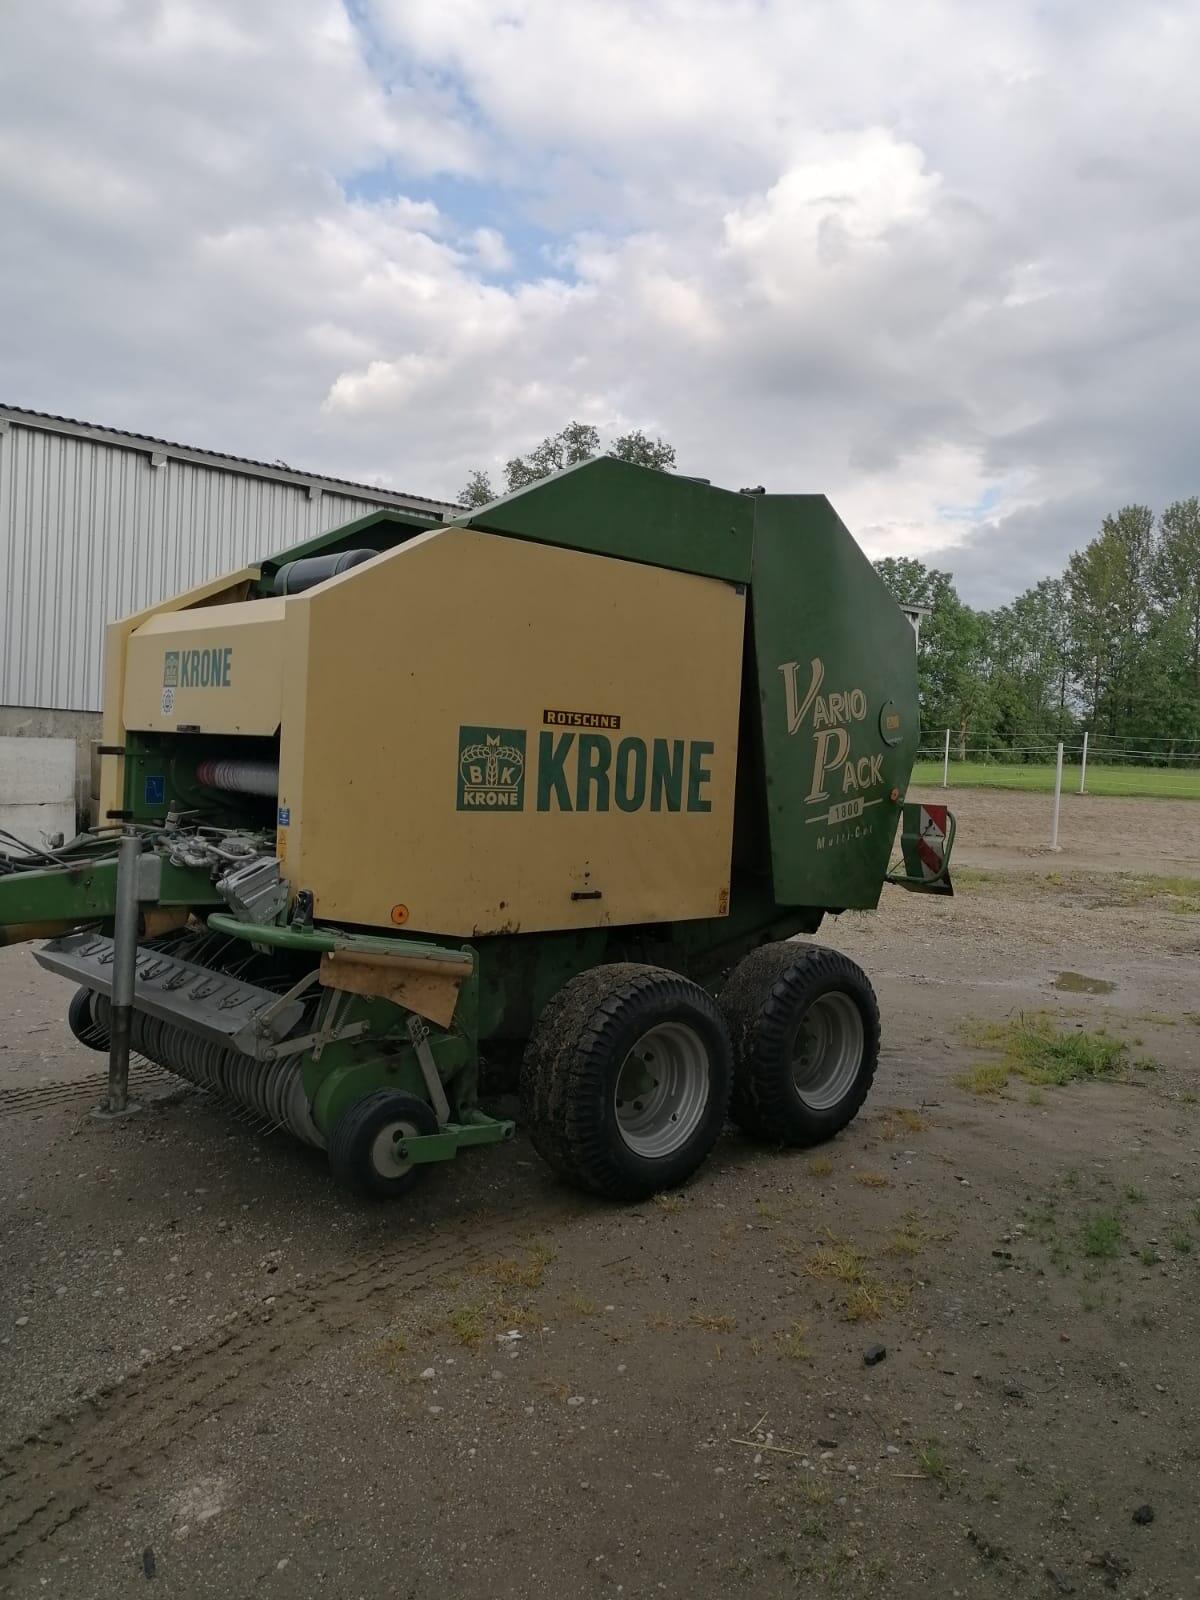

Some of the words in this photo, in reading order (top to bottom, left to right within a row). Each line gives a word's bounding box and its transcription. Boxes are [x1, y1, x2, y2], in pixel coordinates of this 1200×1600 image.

[180, 648, 232, 687] KRONE
[546, 711, 618, 728] ROTSCHNE
[469, 765, 483, 783] B
[500, 766, 516, 784] K
[536, 730, 715, 813] KRONE
[463, 791, 519, 806] KRONE
[835, 801, 859, 820] 1800
